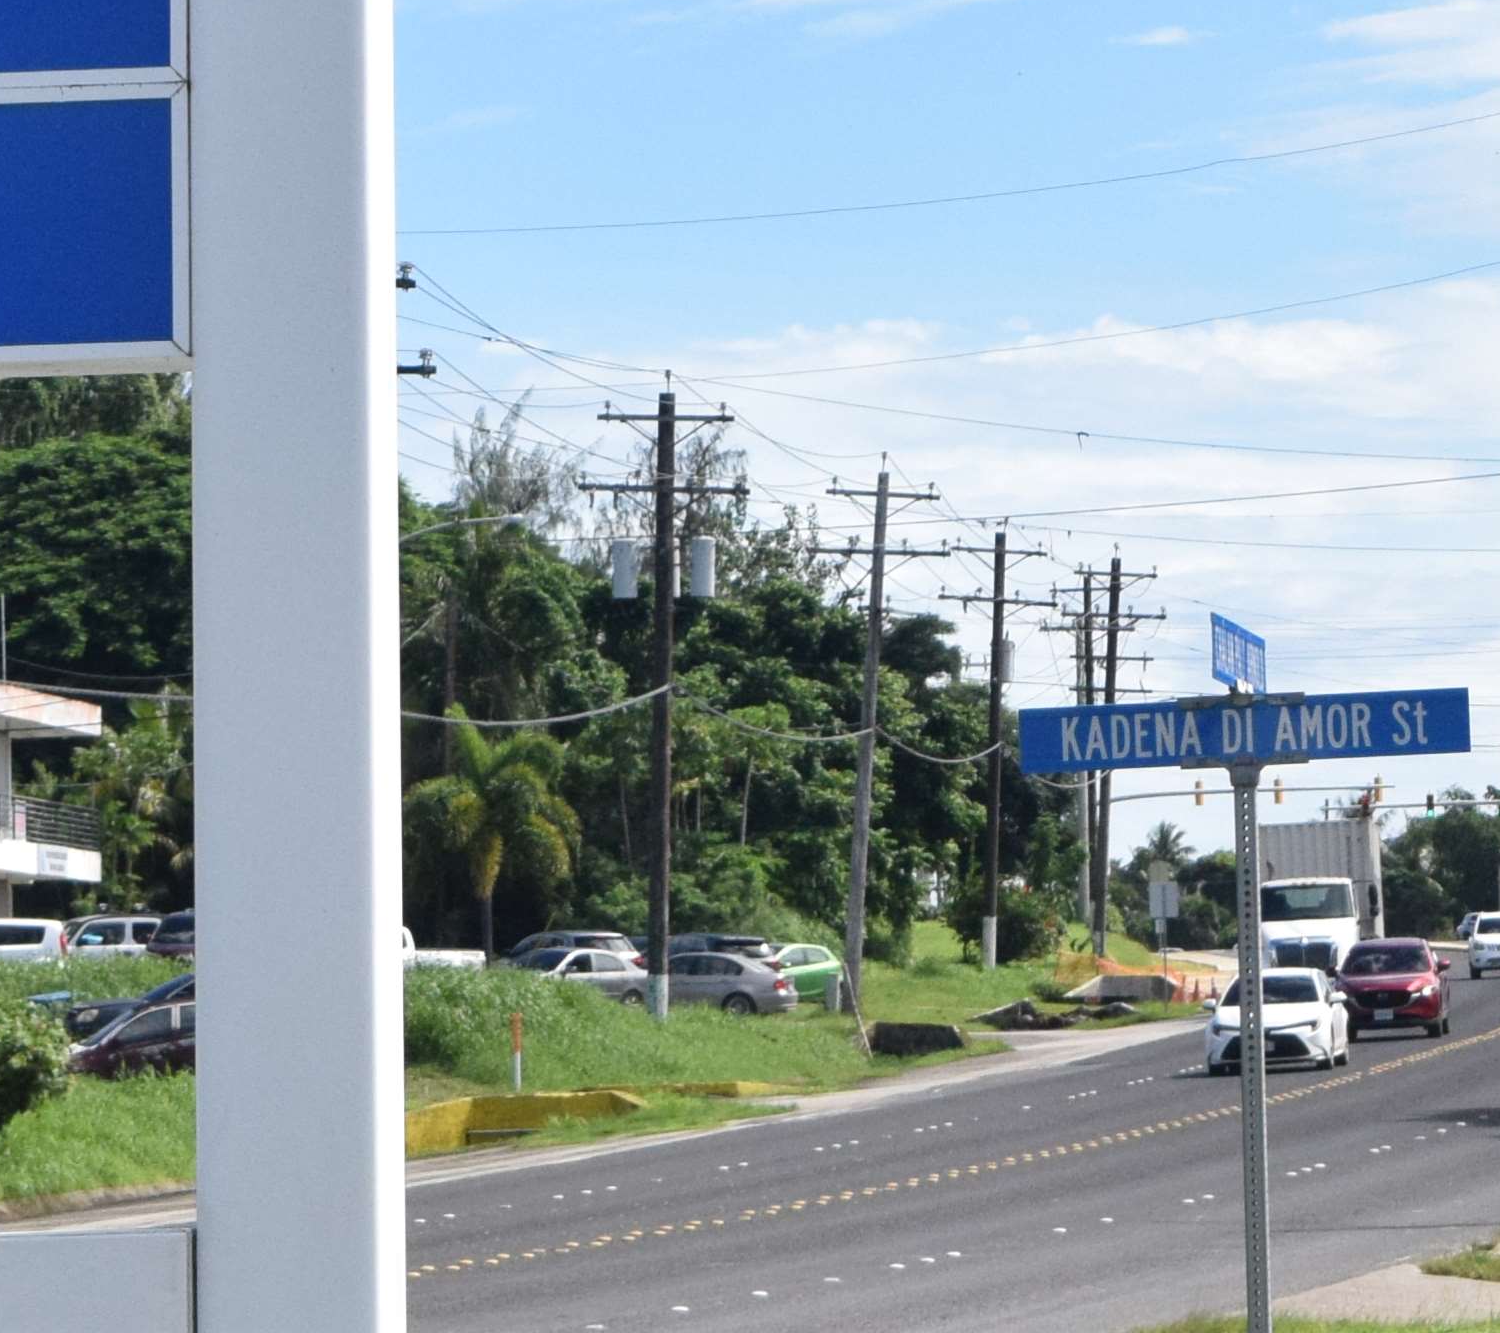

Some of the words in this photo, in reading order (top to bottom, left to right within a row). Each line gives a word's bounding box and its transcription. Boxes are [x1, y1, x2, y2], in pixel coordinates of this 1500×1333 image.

[1061, 711, 1203, 762] KADENA
[1222, 707, 1254, 755] DI
[1274, 702, 1372, 752] AMOR
[1391, 700, 1429, 746] St
